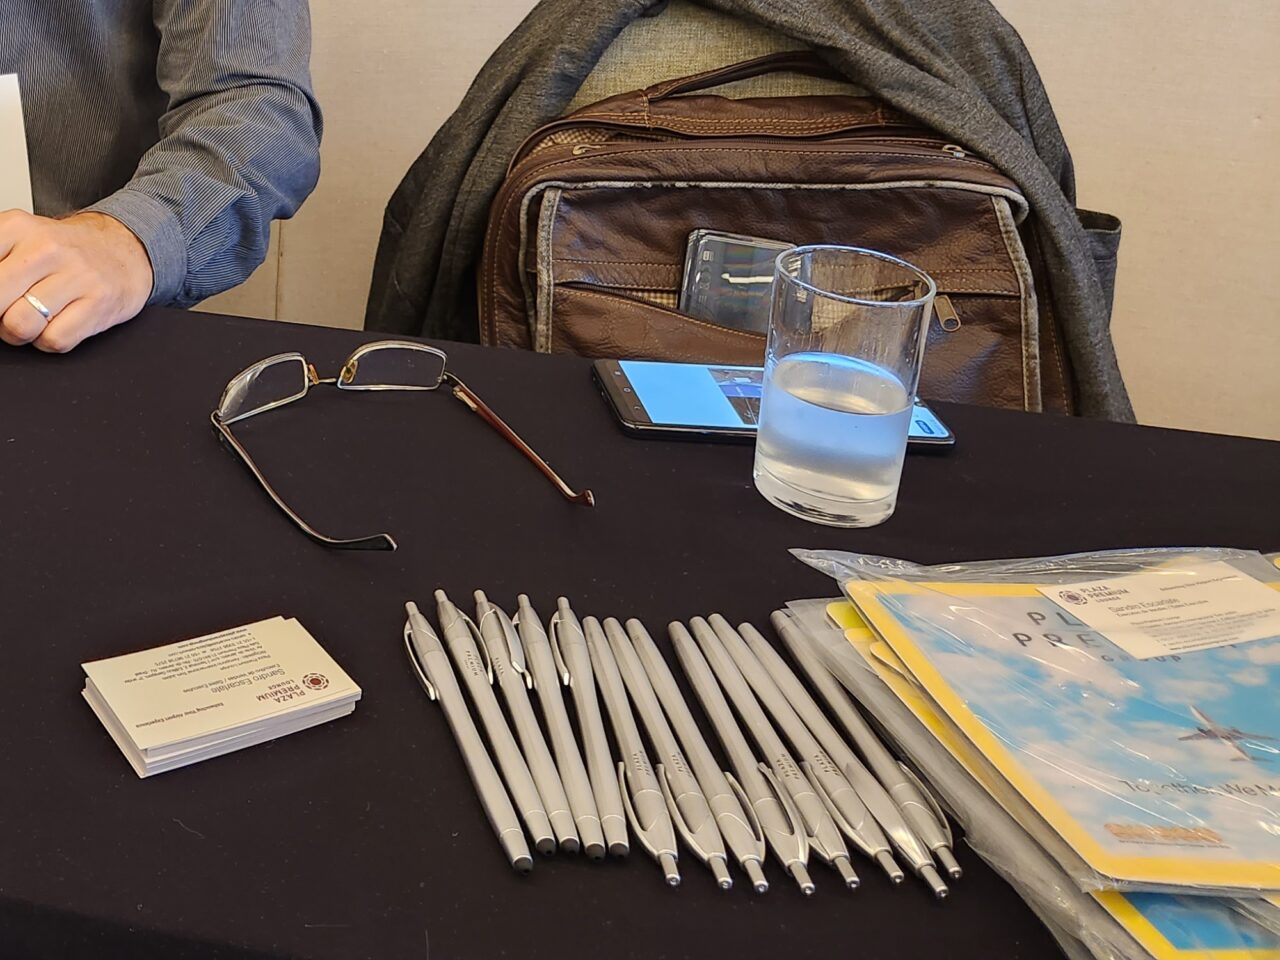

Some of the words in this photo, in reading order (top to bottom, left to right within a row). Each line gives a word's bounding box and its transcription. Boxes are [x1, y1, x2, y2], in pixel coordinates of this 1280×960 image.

[251, 668, 286, 681] Sandro
[255, 684, 300, 701] PREMIUM
[272, 690, 305, 703] PLAZA
